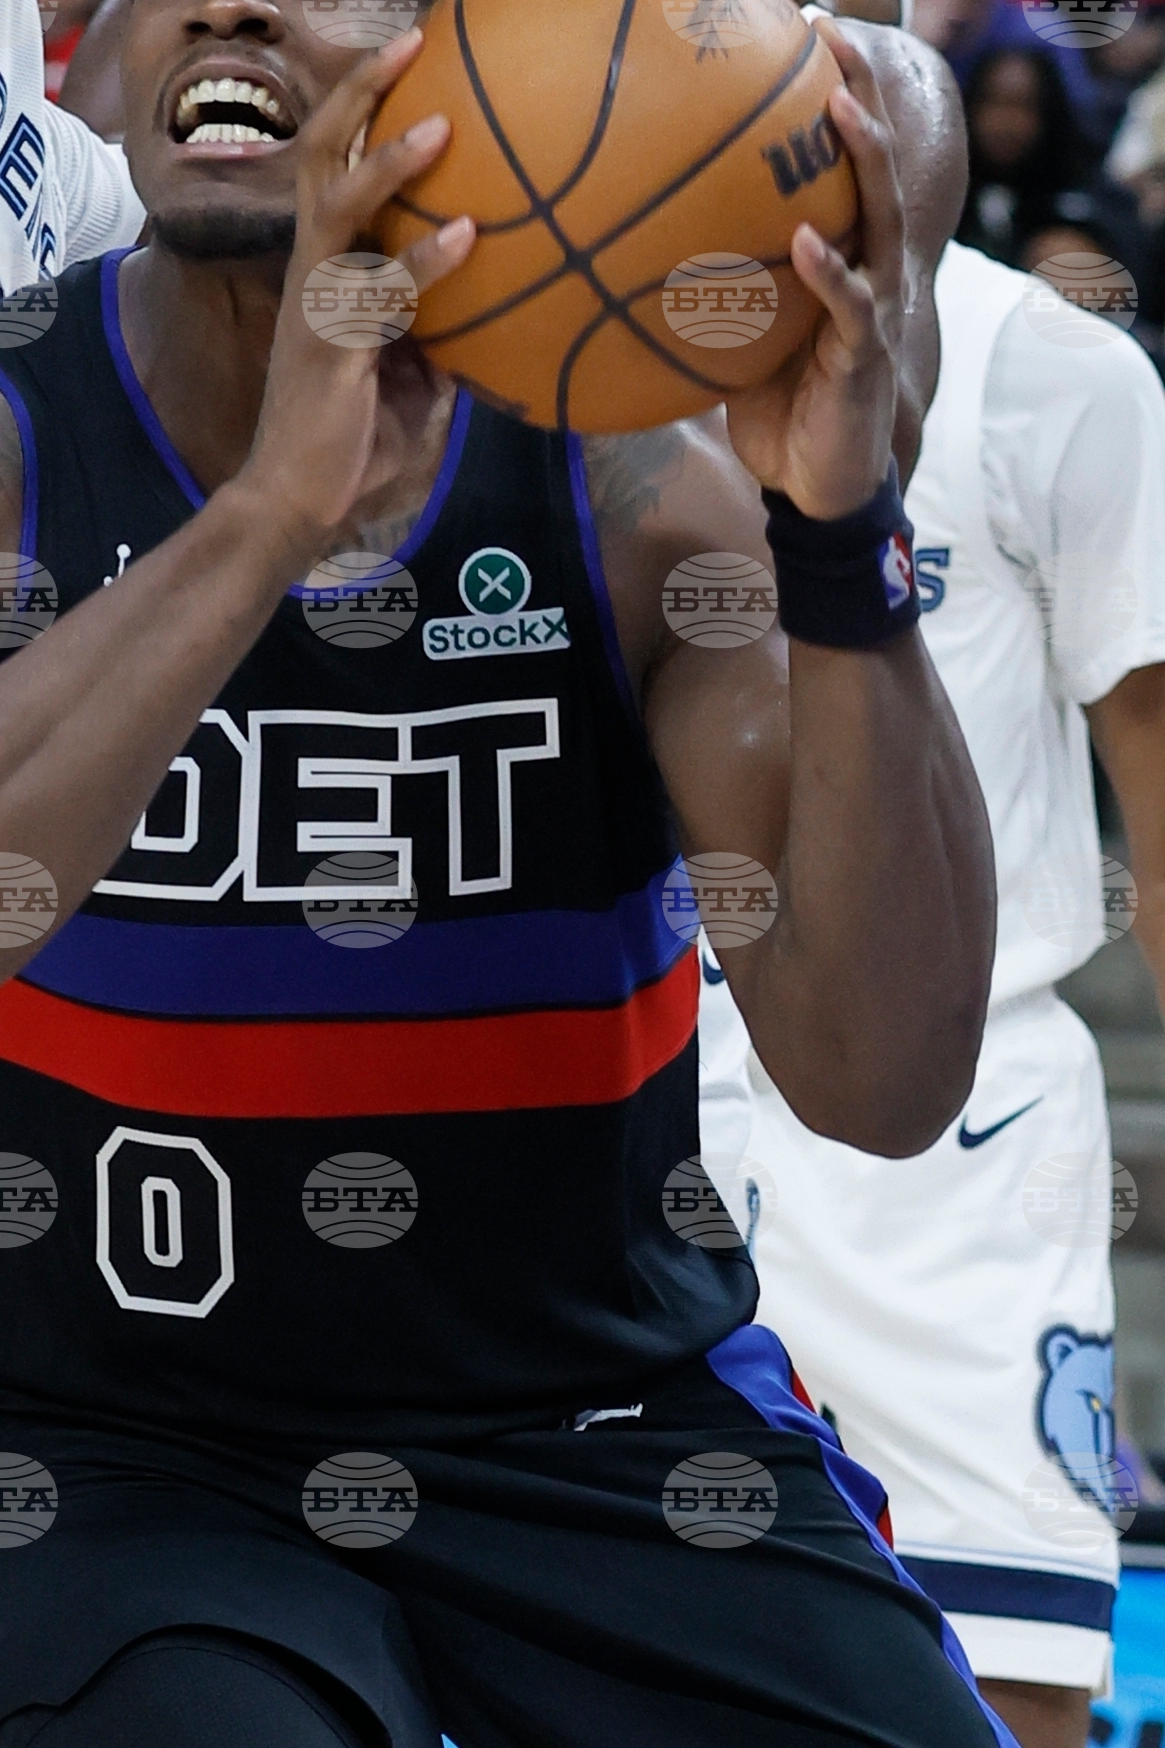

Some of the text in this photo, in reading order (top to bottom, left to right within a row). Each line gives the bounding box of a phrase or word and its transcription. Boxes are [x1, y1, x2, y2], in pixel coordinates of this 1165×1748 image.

[428, 613, 570, 654] StockX
[91, 698, 560, 903] DET
[95, 1125, 235, 1319] 0
